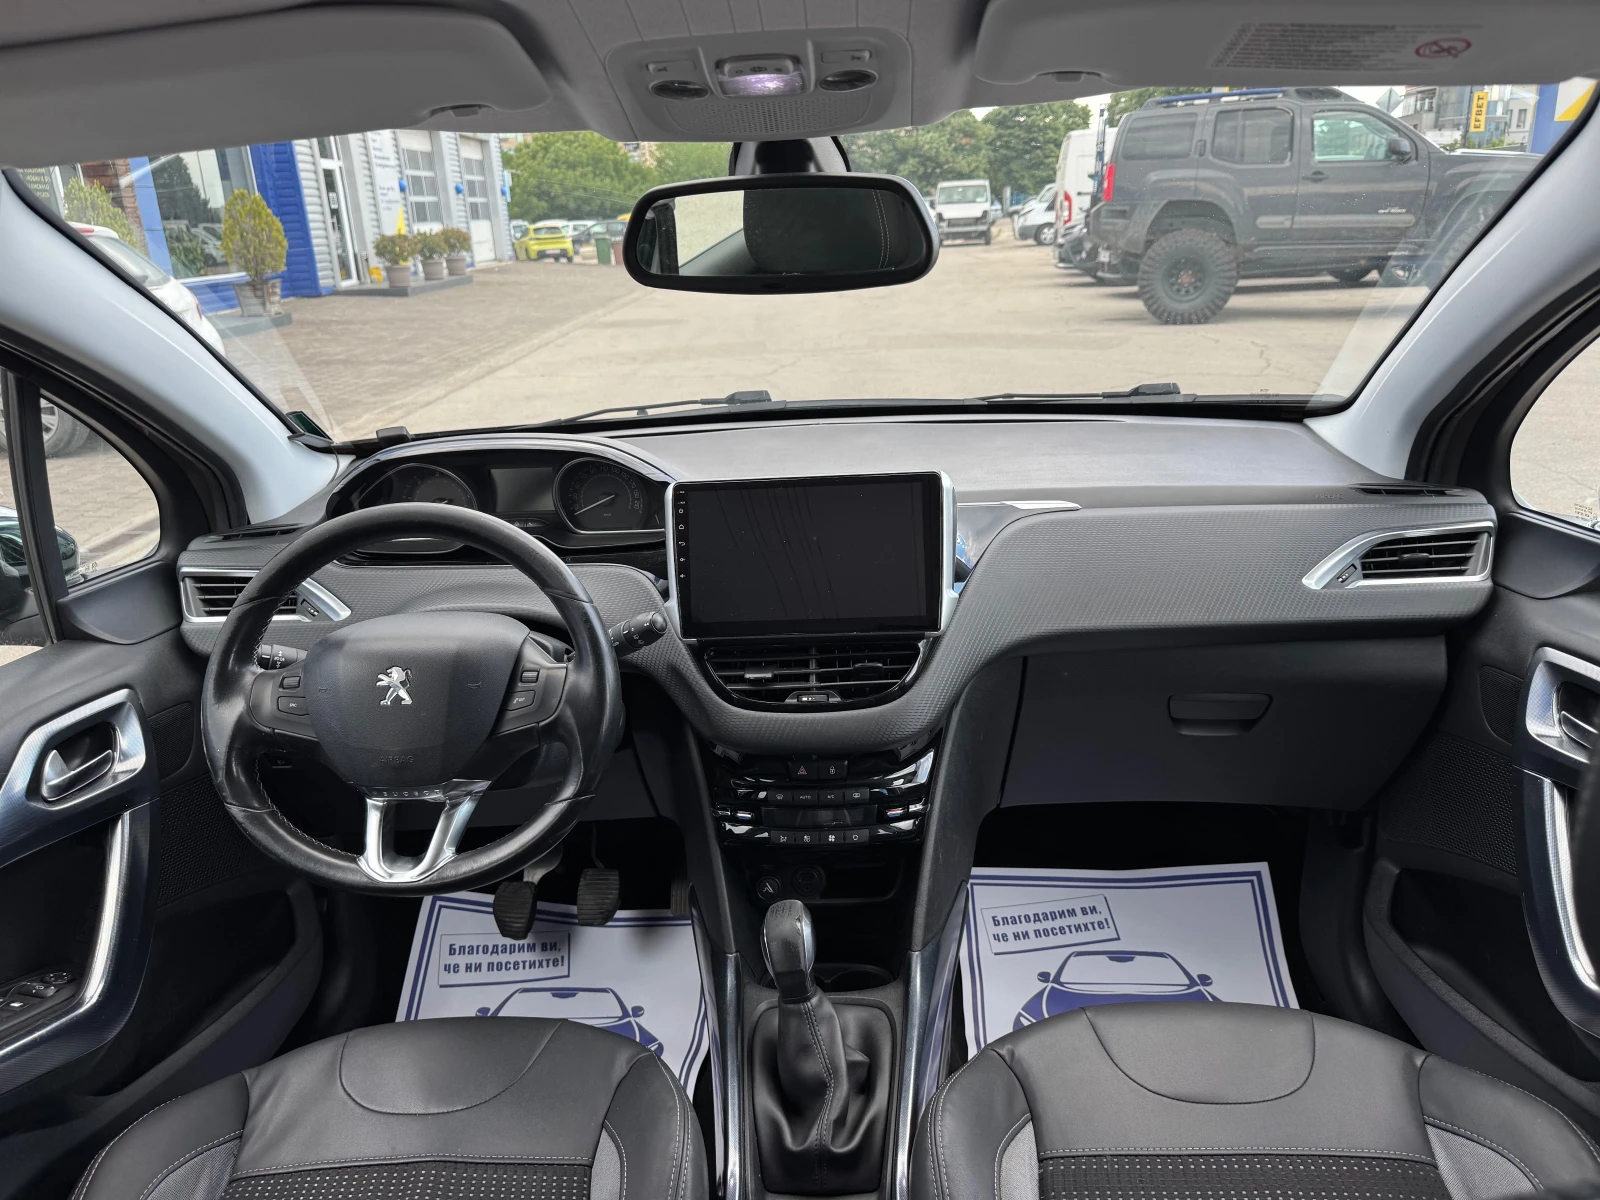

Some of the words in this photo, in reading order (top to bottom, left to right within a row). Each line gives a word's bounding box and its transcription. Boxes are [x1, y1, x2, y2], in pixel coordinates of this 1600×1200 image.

[1473, 94, 1485, 129] EFBET
[380, 755, 414, 764] AIRBAG
[991, 907, 1078, 927] Благодарим
[1079, 905, 1102, 916] ви,
[992, 931, 1009, 943] че
[1012, 930, 1031, 941] ни
[1033, 917, 1111, 939] посетихте!
[448, 942, 537, 956] Благодарим
[540, 941, 561, 953] ви,
[443, 962, 460, 974] че
[464, 962, 483, 973] ни
[486, 955, 565, 972] посетихте!
